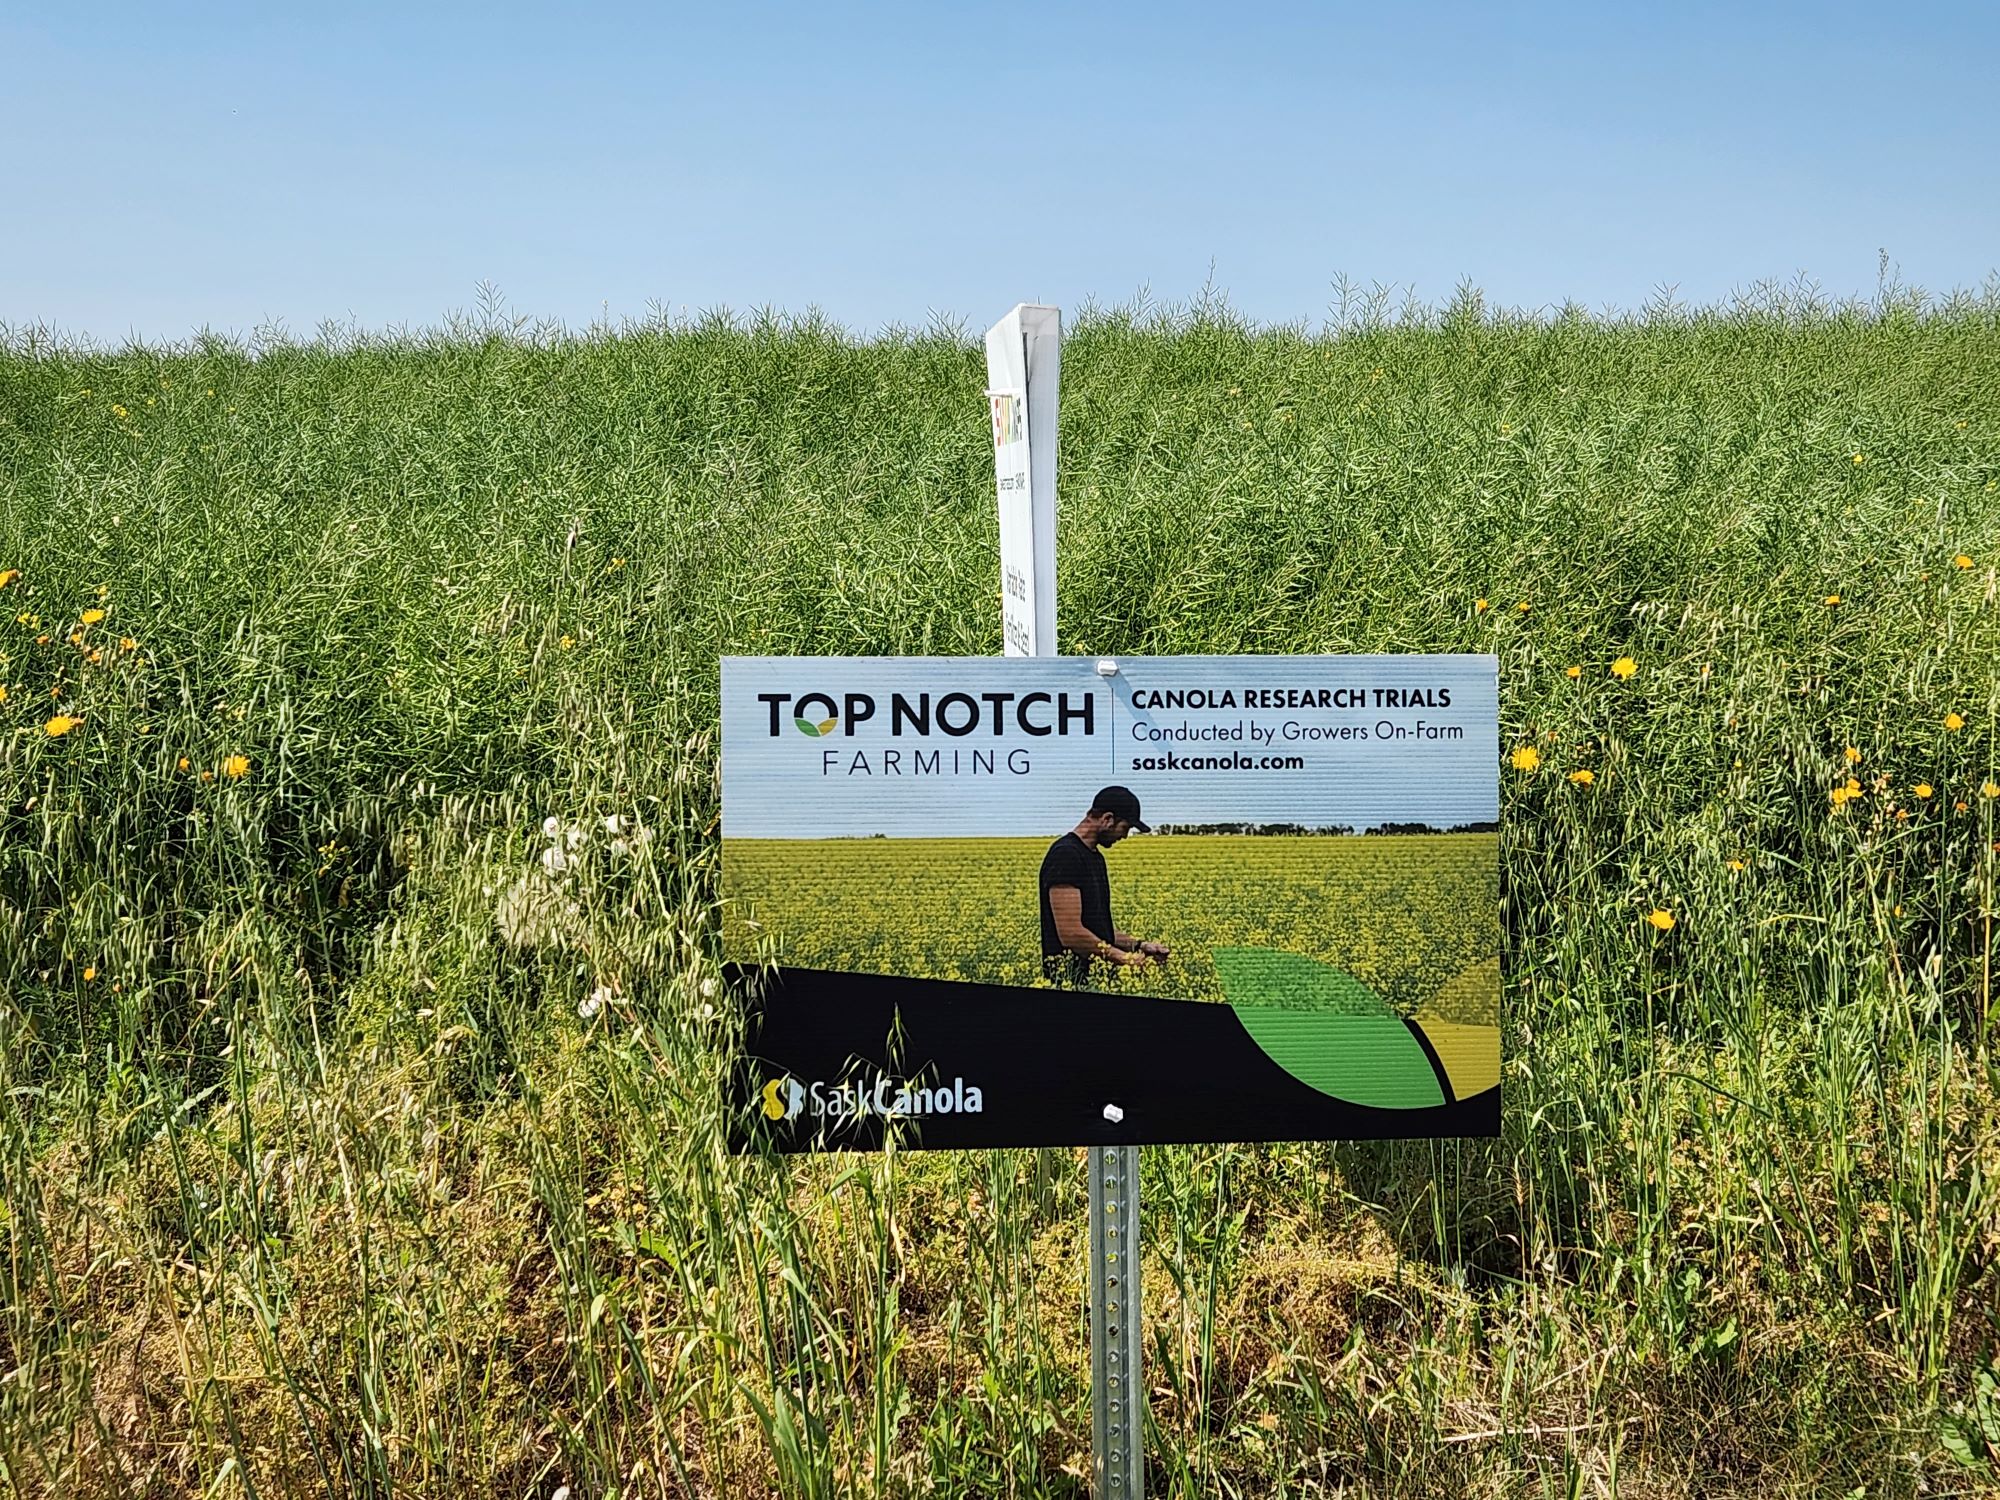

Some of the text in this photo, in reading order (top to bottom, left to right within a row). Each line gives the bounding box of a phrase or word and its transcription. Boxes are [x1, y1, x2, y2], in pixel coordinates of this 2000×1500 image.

[1131, 688, 1451, 709] CANOLA RESEARCH TRIALS
[758, 692, 1095, 738] TOP NOTCH
[1131, 720, 1464, 746] Conducted by Growers On-Farm
[823, 748, 1030, 776] FARMING
[1131, 751, 1304, 770] saskcanola.com
